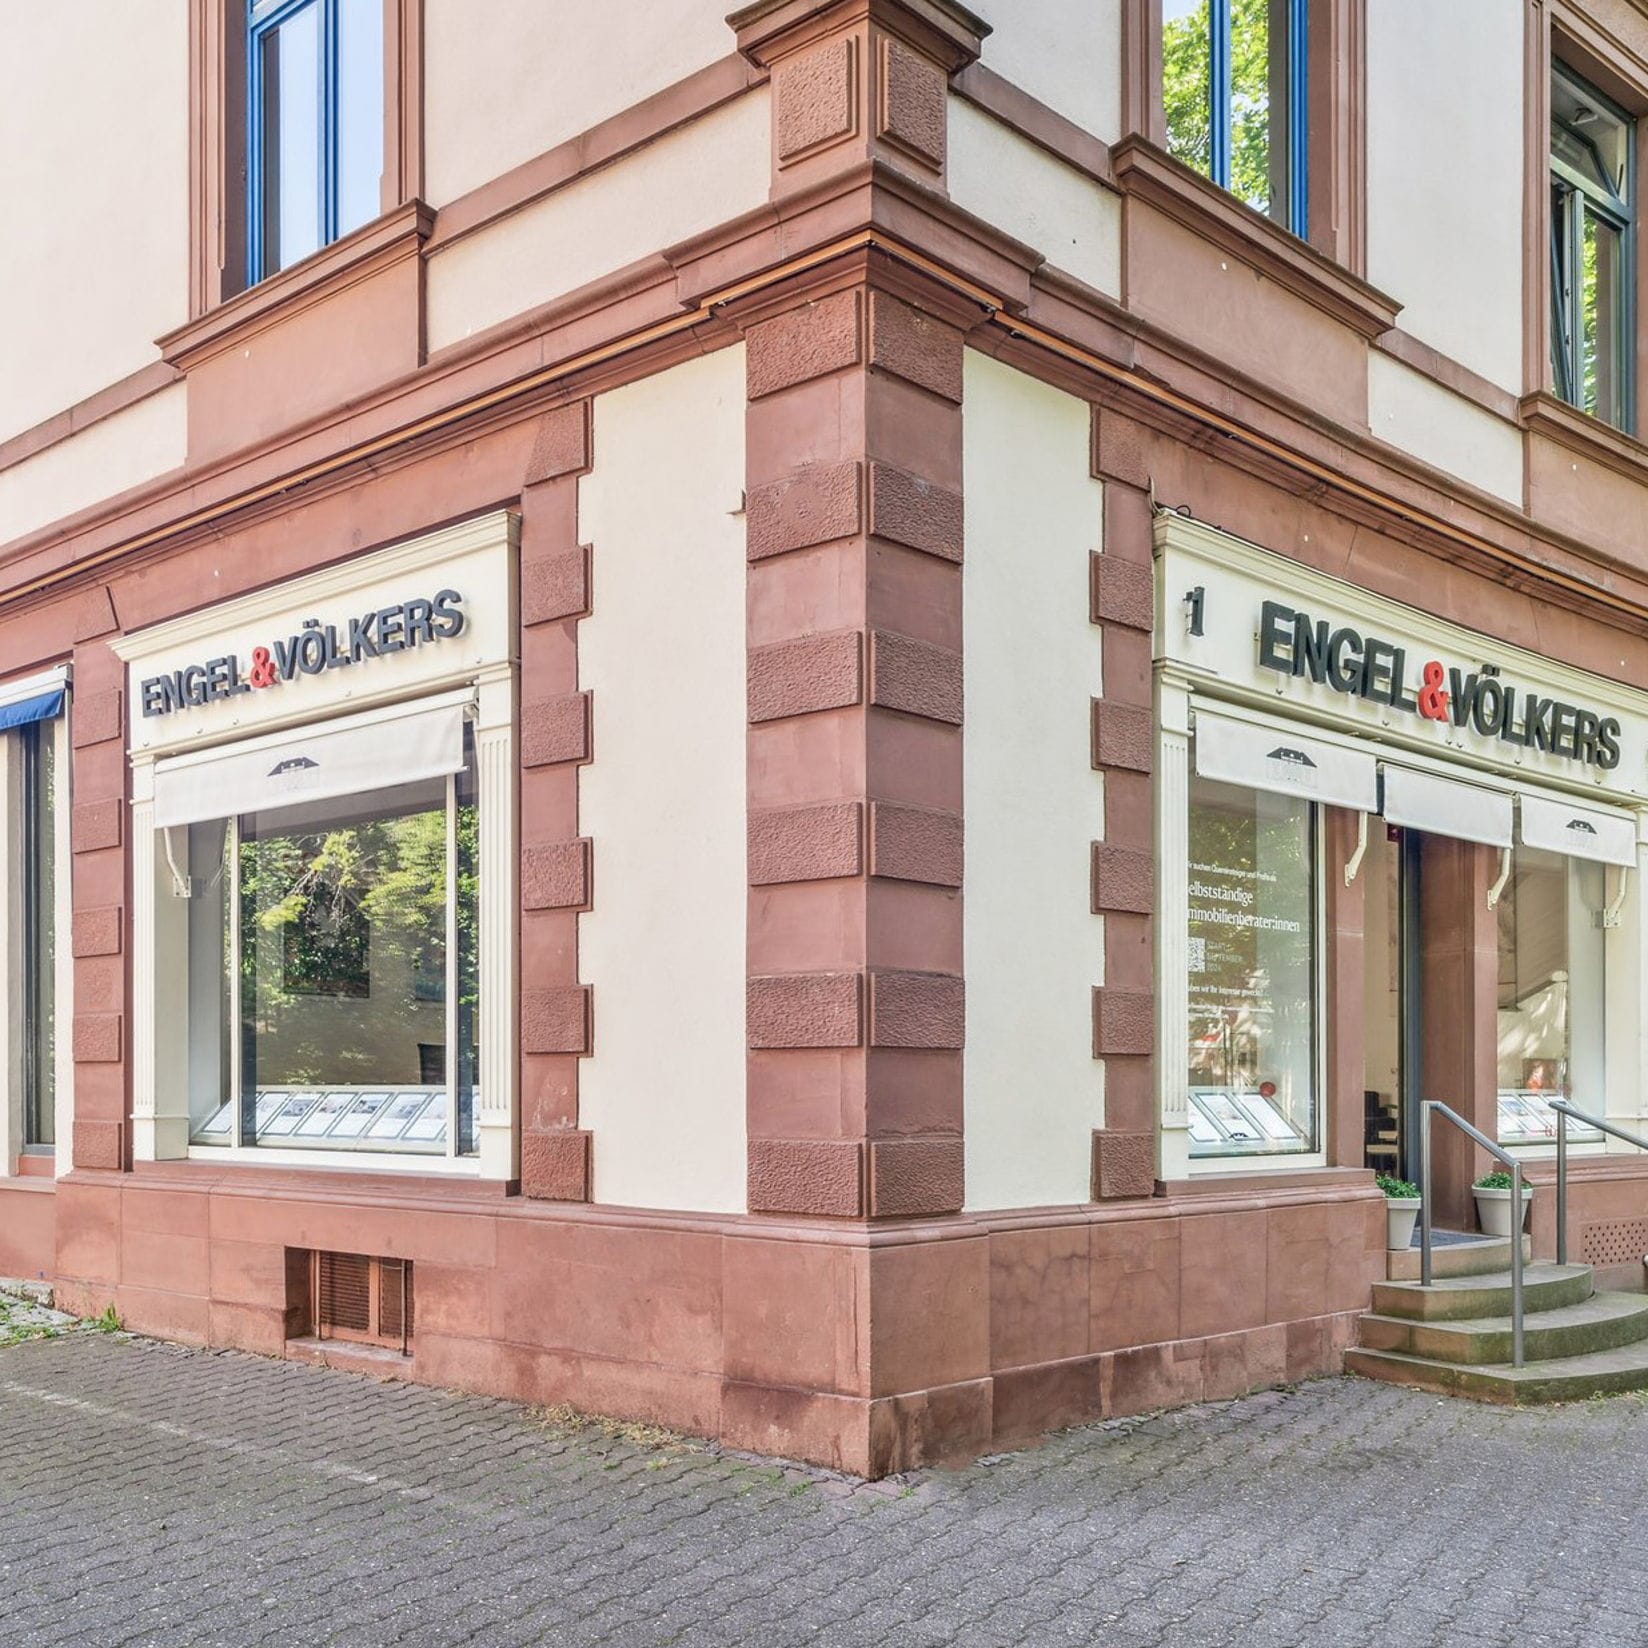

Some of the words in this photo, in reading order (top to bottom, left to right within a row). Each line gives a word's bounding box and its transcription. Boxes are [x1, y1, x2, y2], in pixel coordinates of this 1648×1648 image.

[1184, 586, 1205, 637] 1
[1188, 880, 1254, 907] elbstständige
[1188, 907, 1300, 933] mmobilienberater:innen
